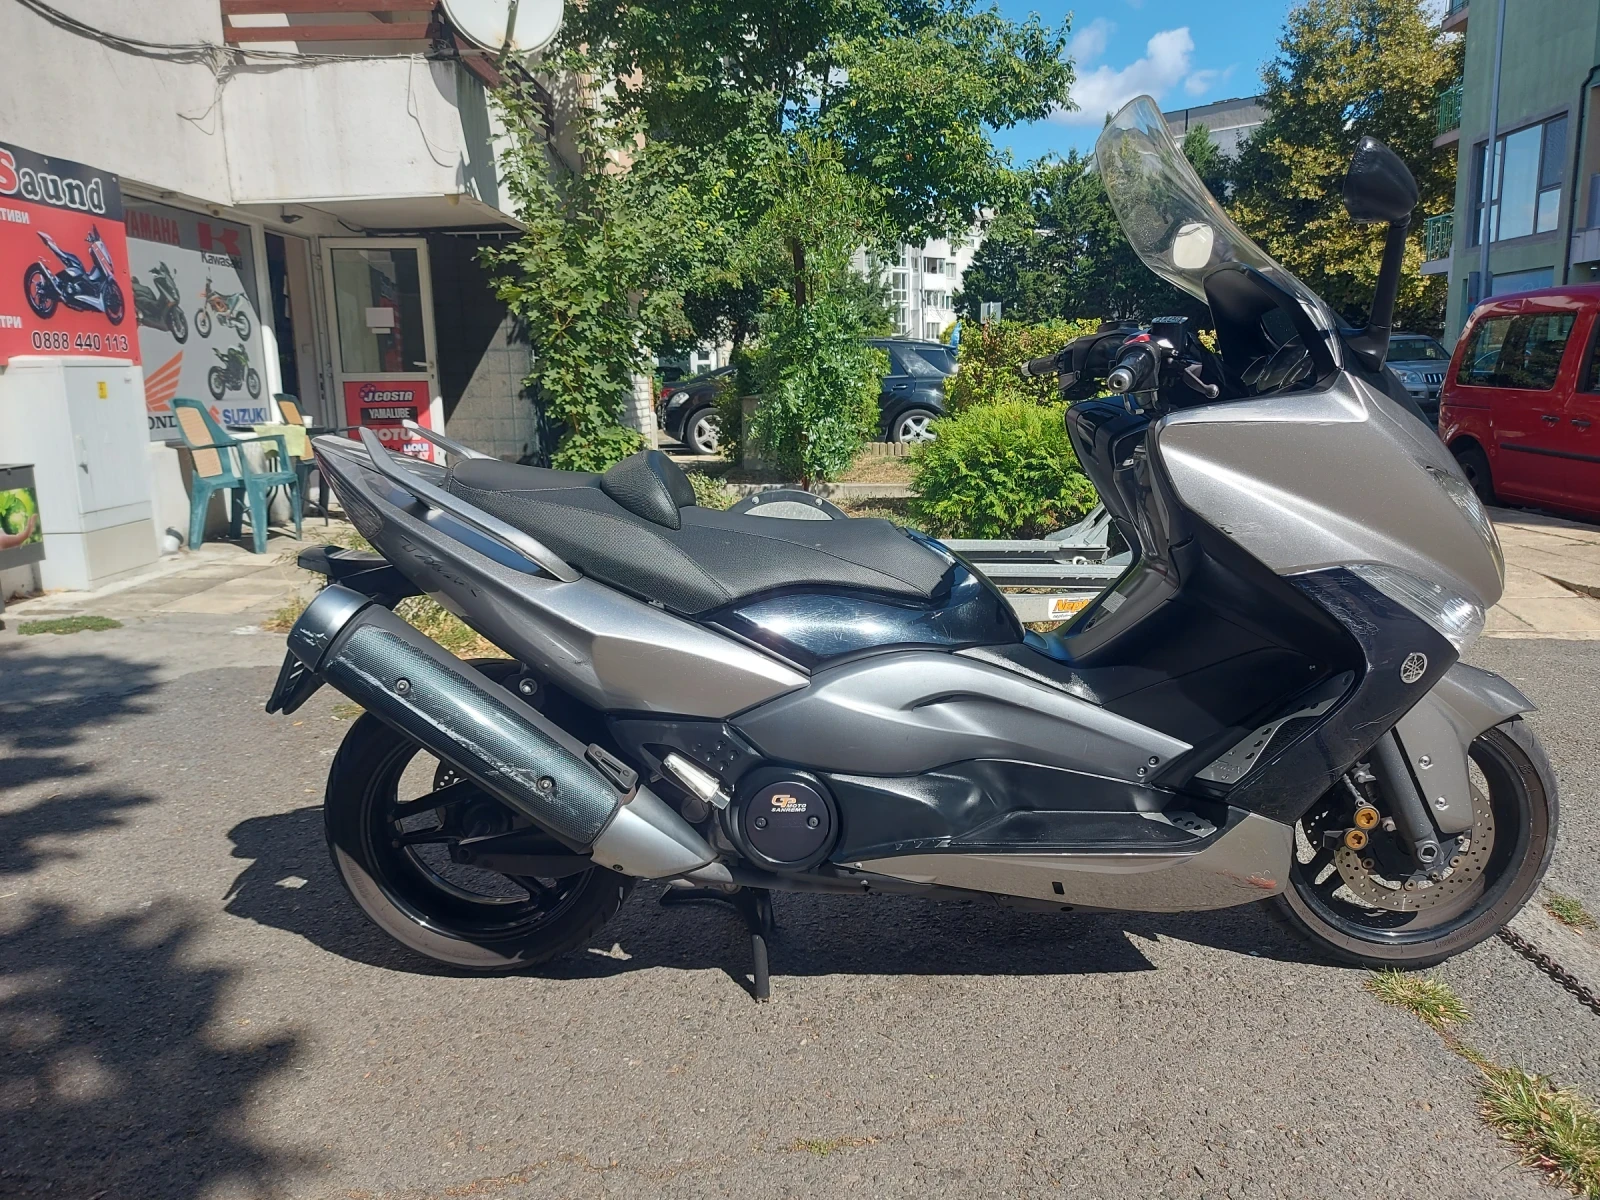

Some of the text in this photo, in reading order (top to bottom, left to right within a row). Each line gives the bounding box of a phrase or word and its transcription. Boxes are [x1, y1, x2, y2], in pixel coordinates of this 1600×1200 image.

[32, 330, 129, 353] 0888 440 113
[222, 407, 268, 425] SUZUKI
[369, 408, 411, 419] YAMALUBE
